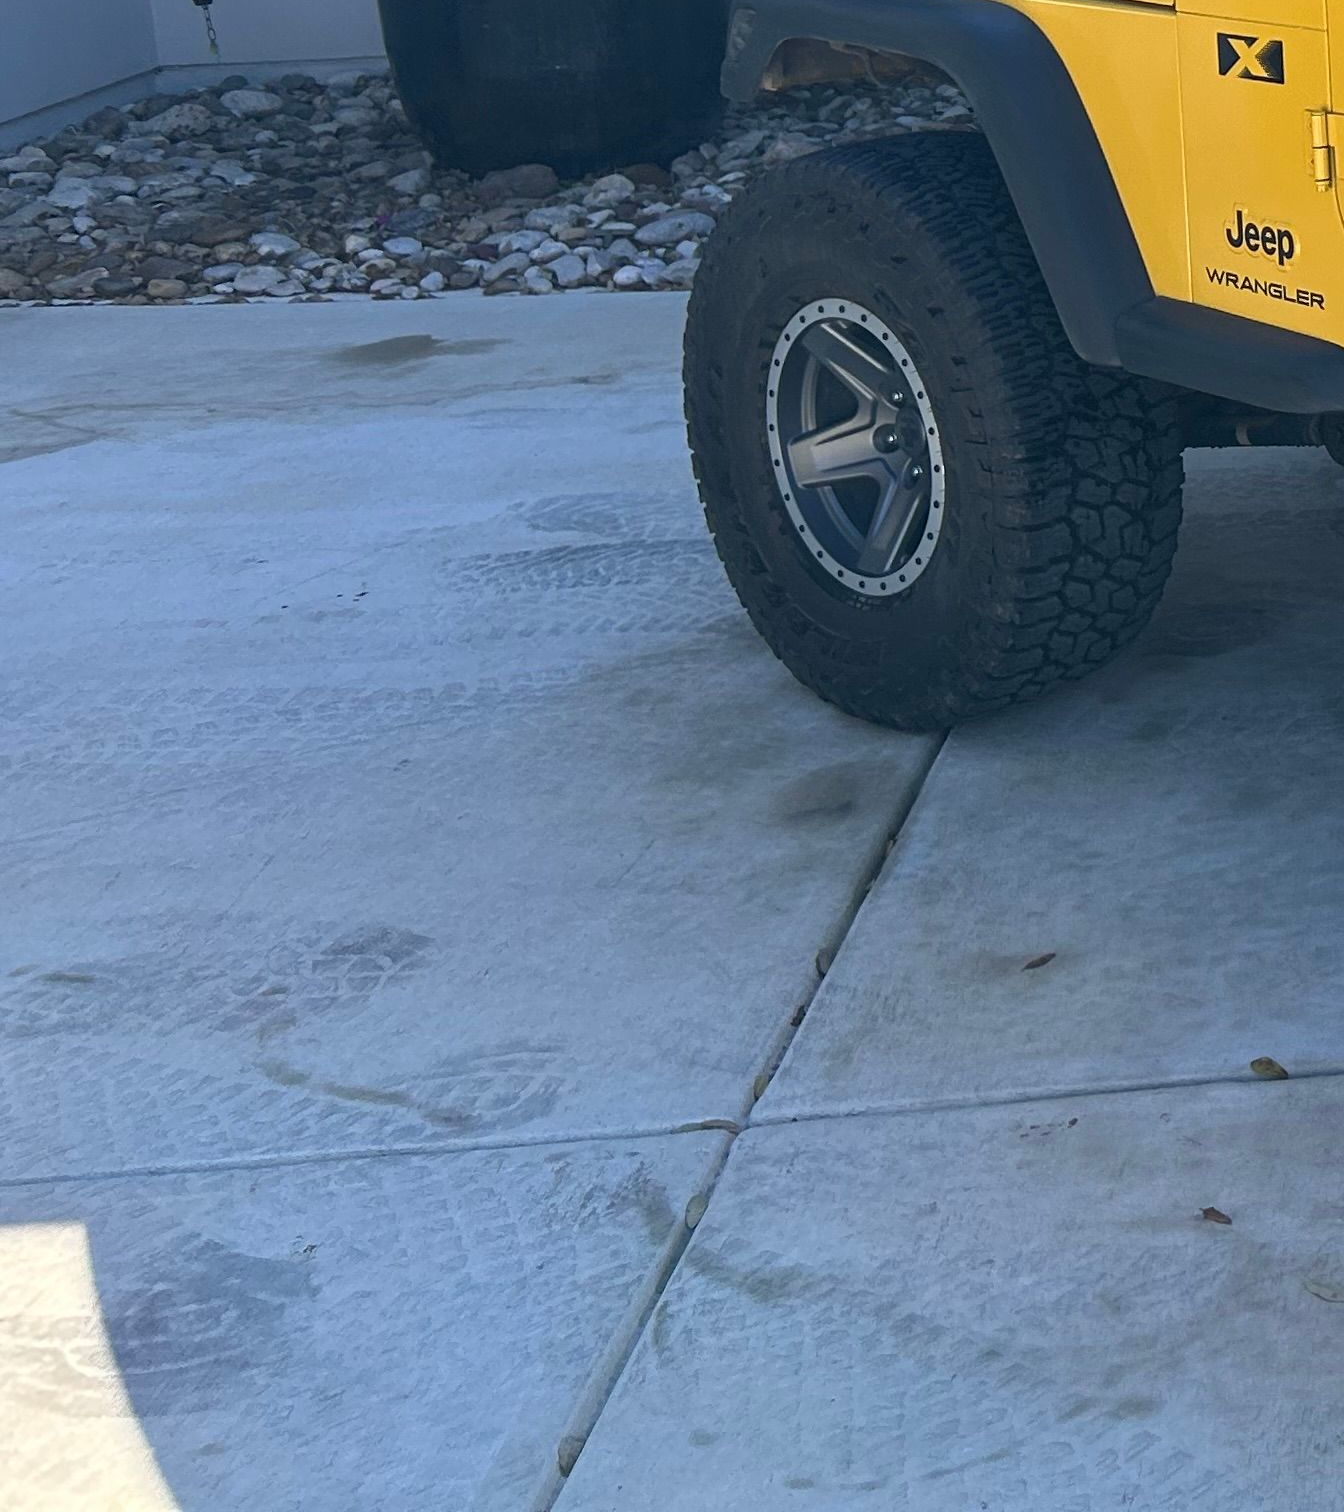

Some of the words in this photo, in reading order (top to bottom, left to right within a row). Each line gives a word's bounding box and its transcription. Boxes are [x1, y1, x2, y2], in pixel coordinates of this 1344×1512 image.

[1222, 35, 1274, 81] X
[1225, 209, 1295, 266] Jeep
[1205, 266, 1325, 310] WRANGLER
